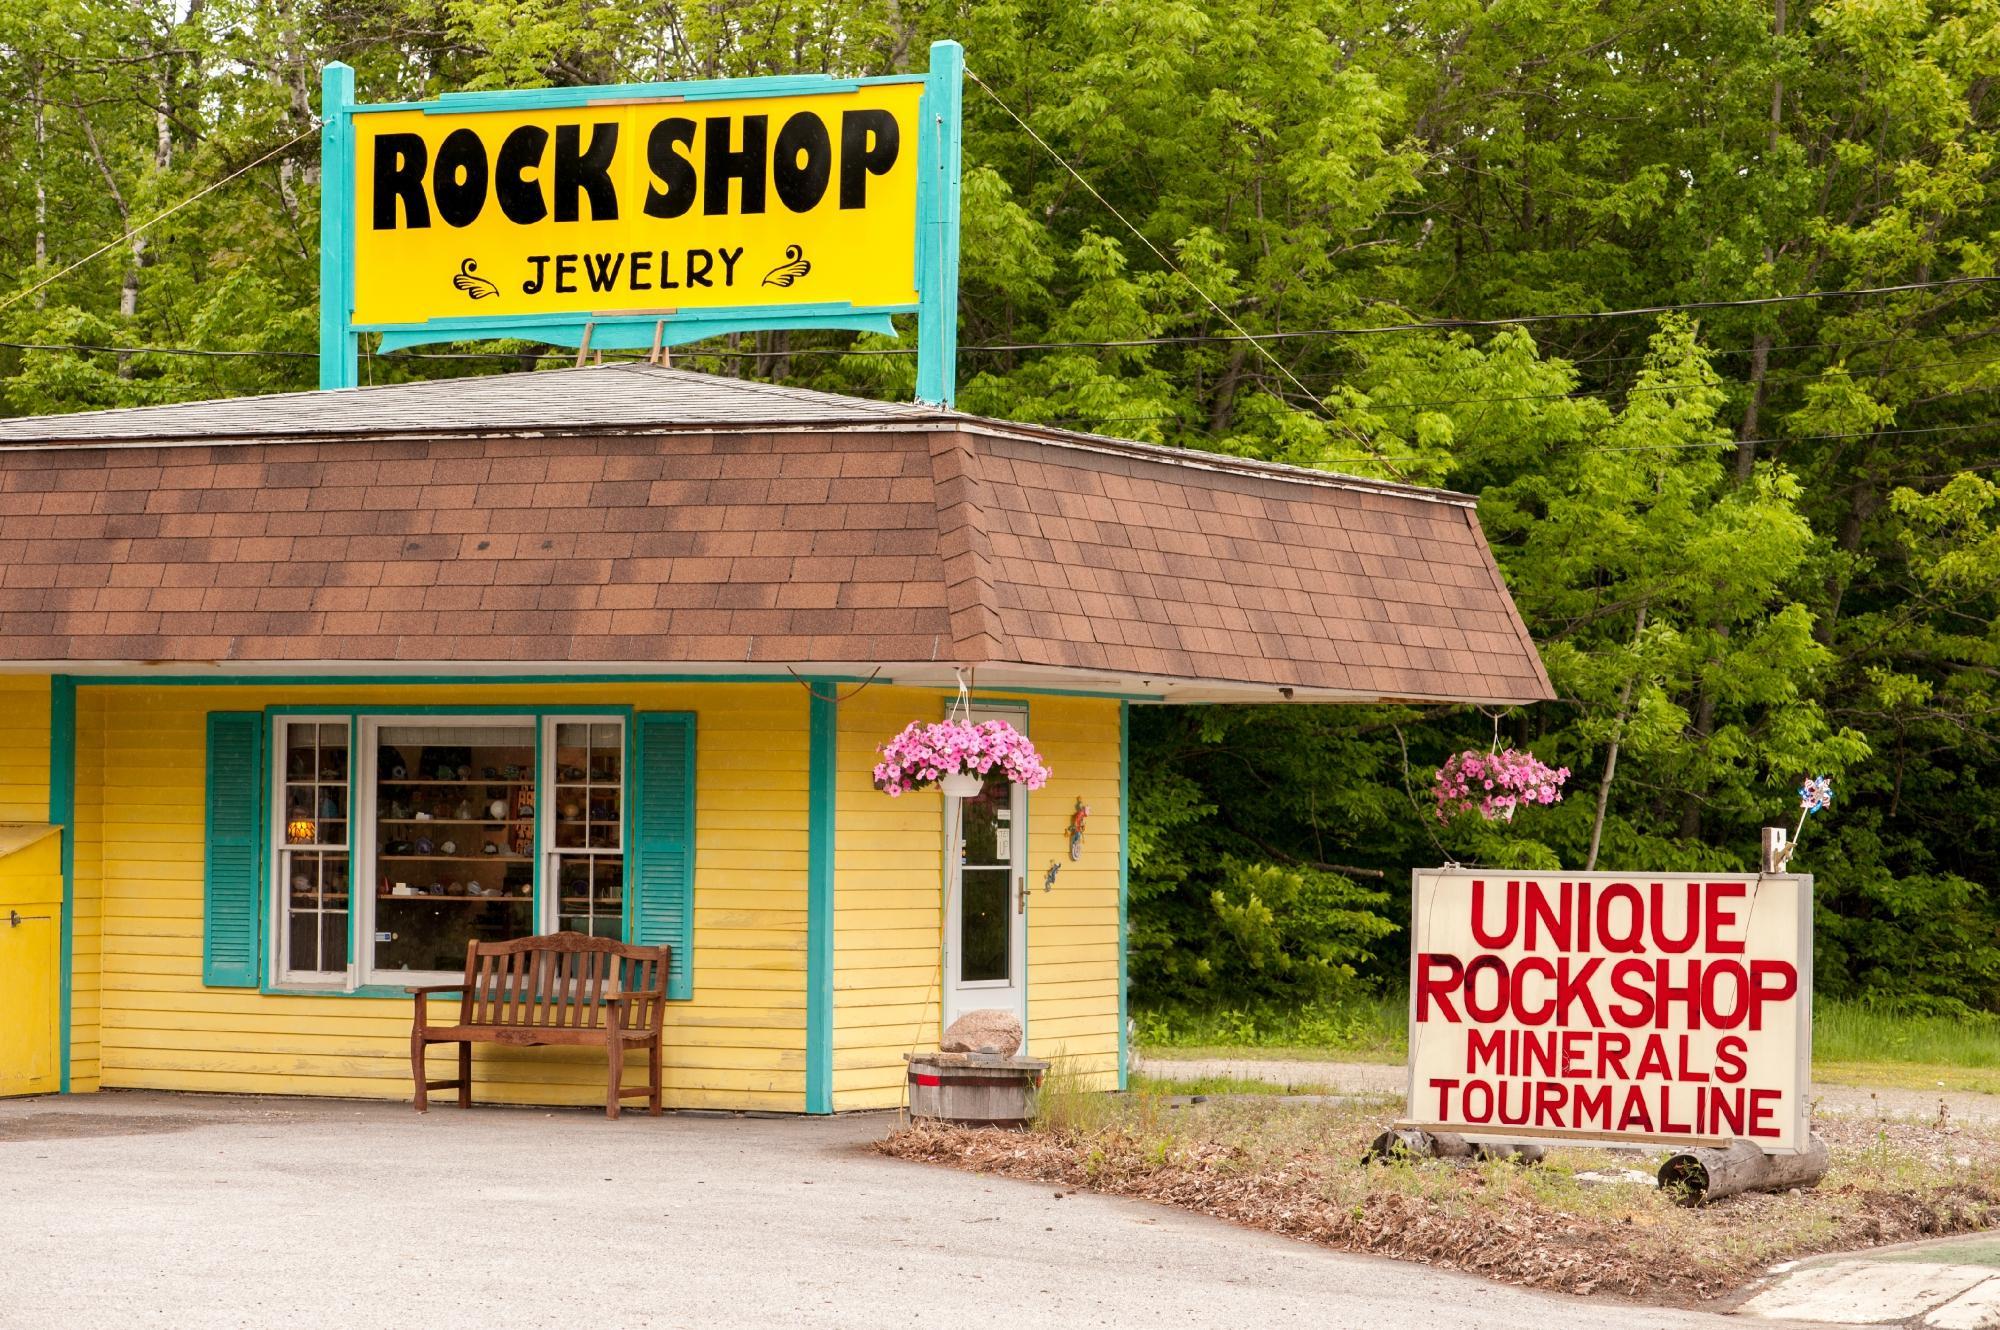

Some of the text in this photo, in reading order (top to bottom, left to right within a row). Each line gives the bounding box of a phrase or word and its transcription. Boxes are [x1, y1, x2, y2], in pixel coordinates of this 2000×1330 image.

[373, 109, 900, 230] ROCK SHOP
[522, 246, 744, 296] JEWELRY
[1470, 880, 1747, 955] UNIQUE
[1466, 1028, 1748, 1084] MINERALS
[1429, 1078, 1782, 1137] TOURMALINE
